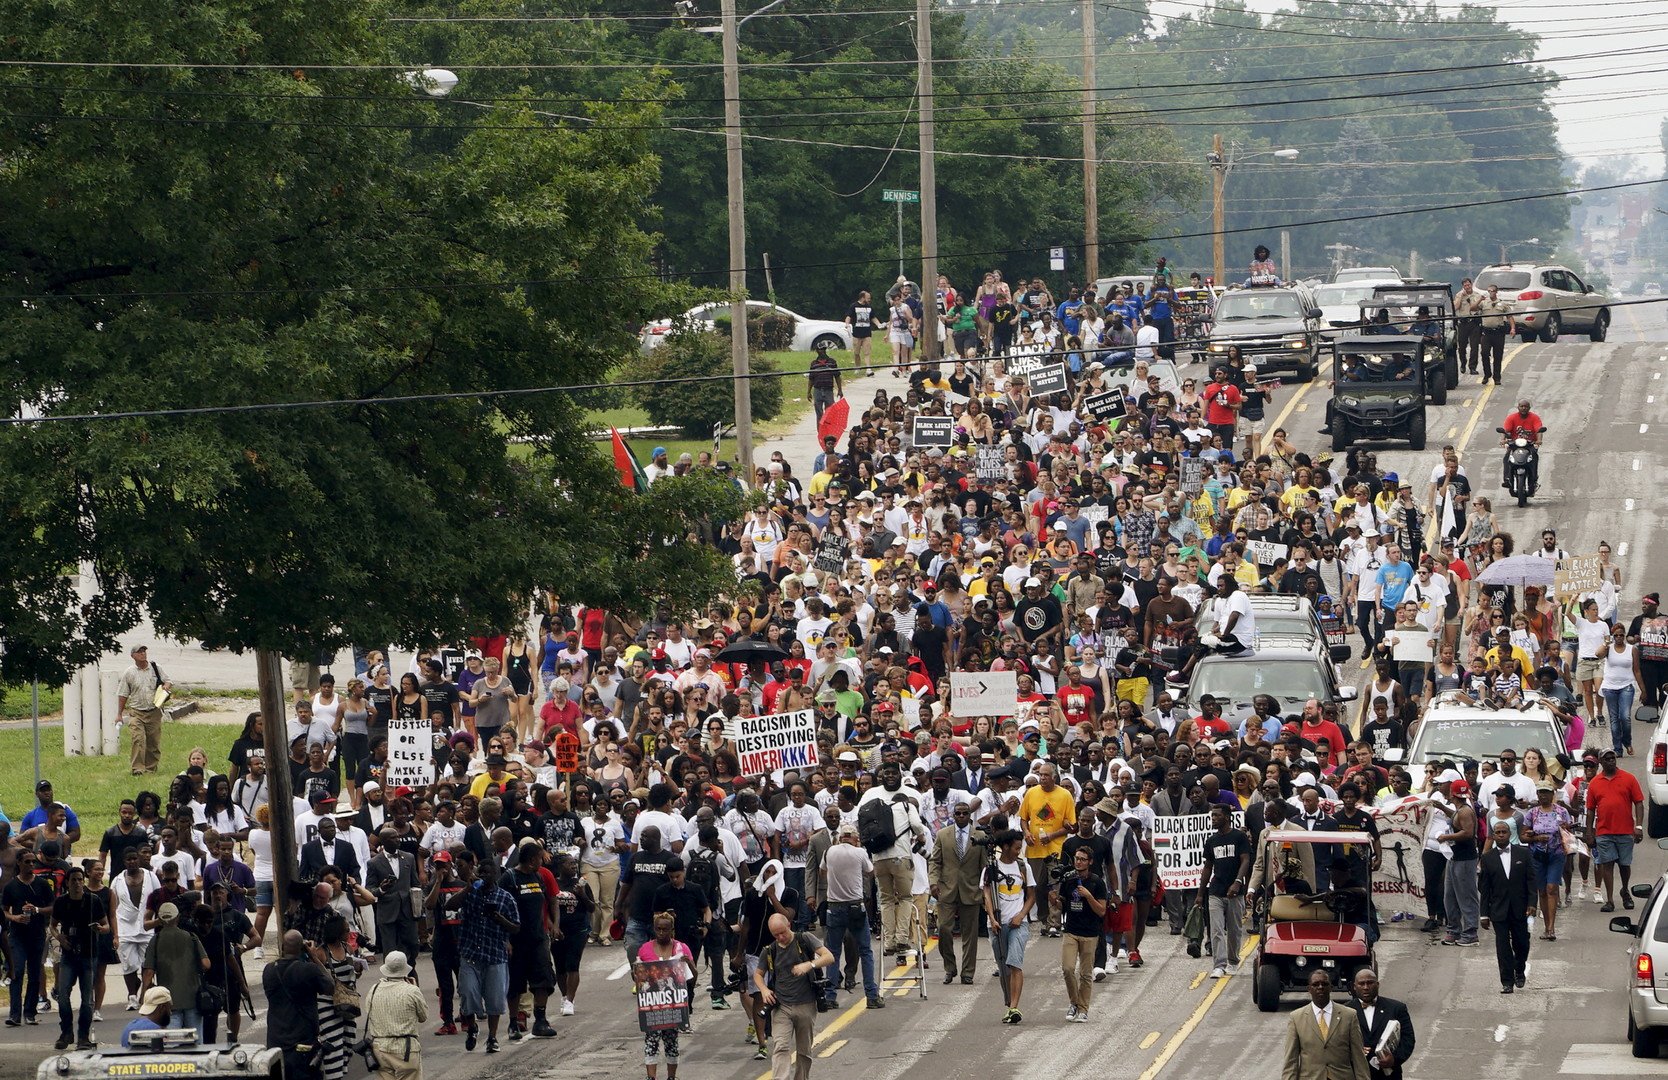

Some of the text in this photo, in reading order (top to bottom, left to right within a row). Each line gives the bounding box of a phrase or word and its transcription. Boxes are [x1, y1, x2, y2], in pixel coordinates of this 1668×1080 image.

[884, 191, 911, 200] DENNIS
[1009, 343, 1044, 356] BLACK
[1012, 355, 1042, 366] LIVES
[1030, 369, 1062, 381] BLACK LIVES
[1036, 377, 1058, 387] MATTER
[1088, 394, 1121, 410] BLACK LIVES
[1095, 403, 1118, 414] MATTER
[979, 448, 1001, 459] BLACK
[981, 459, 1001, 469] LIVES
[1186, 463, 1200, 473] BLAC
[976, 468, 1005, 478] MATTER
[839, 535, 849, 547] UP
[1254, 542, 1276, 551] BLACK
[1555, 557, 1599, 571] ALL BLACK
[1568, 568, 1597, 579] LIVES
[1561, 577, 1599, 592] MATTER
[1641, 632, 1665, 644] HANDS
[952, 686, 980, 698] LIVES
[388, 720, 431, 730] JUSTICE
[741, 712, 807, 735] RACISM IS
[400, 735, 415, 744] OR
[738, 728, 815, 753] DESTROYING
[394, 751, 425, 760] ELSE
[741, 743, 817, 776] AMERIKKKA
[394, 766, 423, 775] MIKE
[387, 776, 430, 786] BROWN
[1154, 817, 1185, 833] BLACK
[1172, 835, 1179, 851] &
[1155, 852, 1181, 868] FOR
[638, 988, 689, 1008] HANDS UP
[108, 1063, 196, 1076] STATE TROOPER
